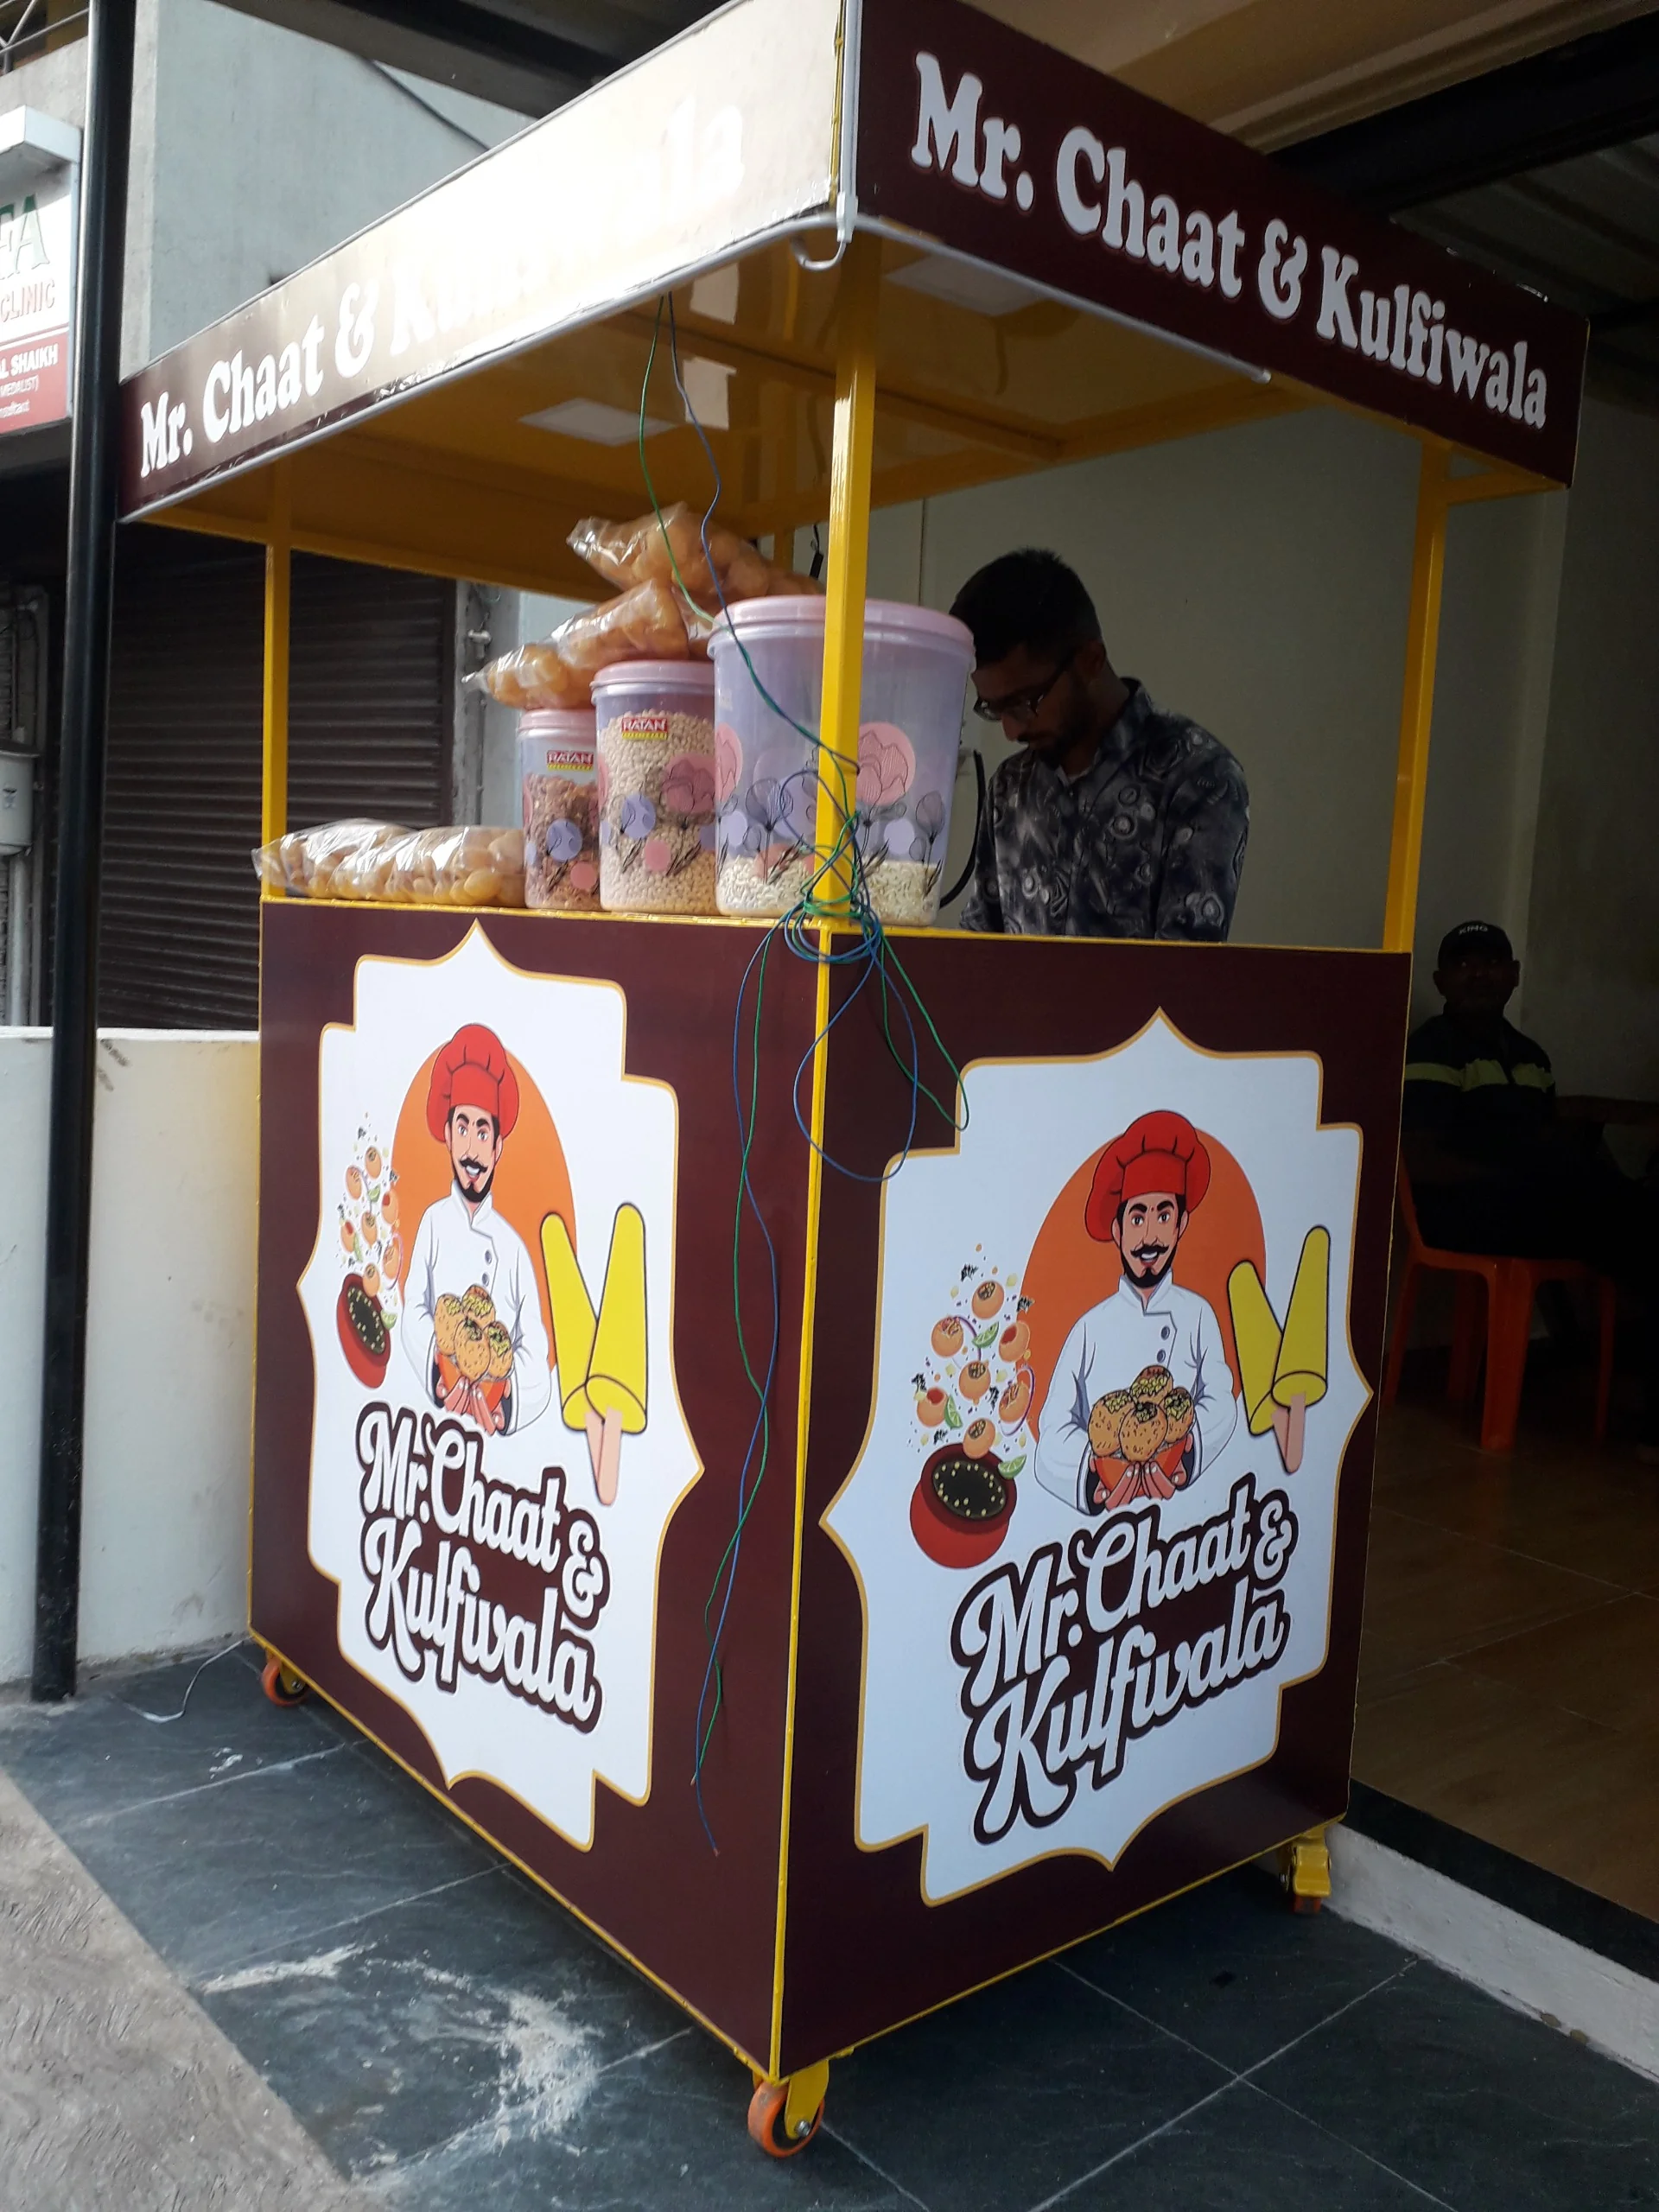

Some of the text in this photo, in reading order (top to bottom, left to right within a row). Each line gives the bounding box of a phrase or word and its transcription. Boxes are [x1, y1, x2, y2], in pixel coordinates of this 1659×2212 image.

[0, 279, 55, 323] CLINIC
[911, 51, 1547, 429] Mr. Chaat & Kulfiwala
[10, 343, 58, 376] SHAIKH
[140, 391, 193, 478] Mr.
[202, 314, 324, 443] Chaat
[334, 277, 381, 378] &
[623, 718, 666, 731] RATAN
[359, 1410, 603, 1618] Mr. Chaat &
[960, 1484, 1293, 1707] Mr. Chaat &
